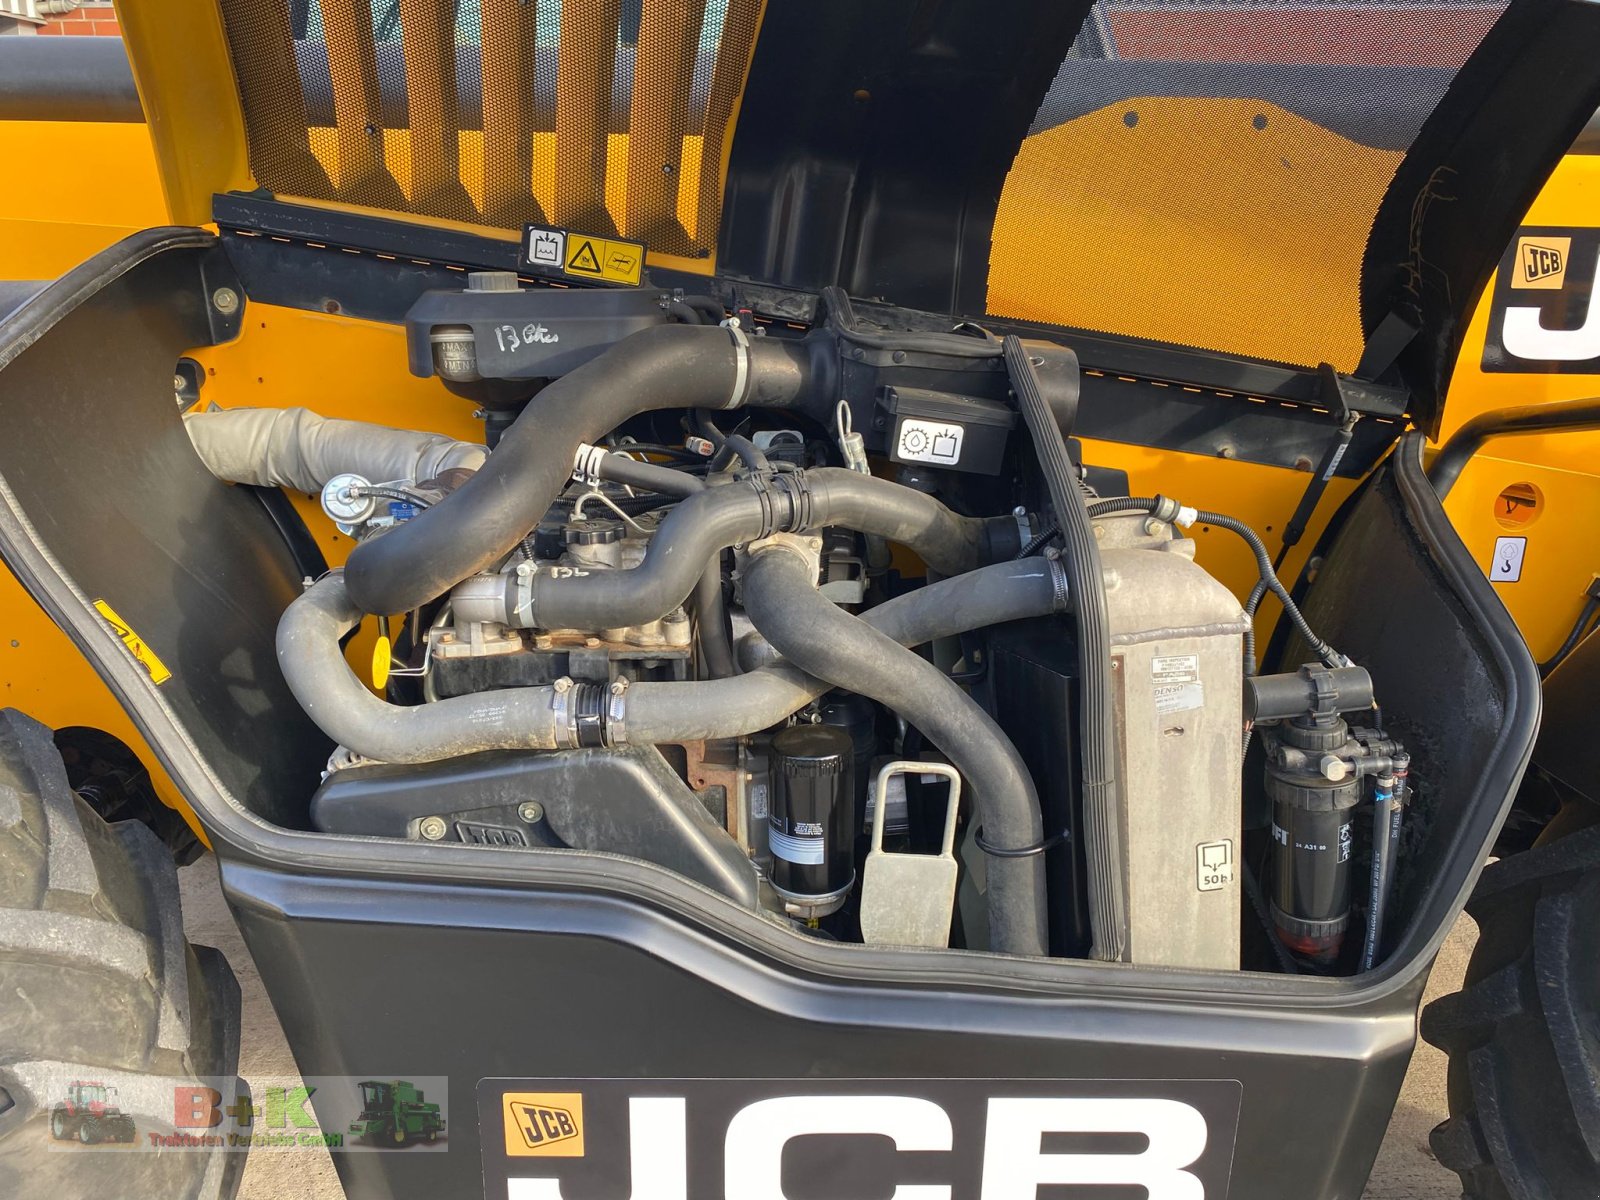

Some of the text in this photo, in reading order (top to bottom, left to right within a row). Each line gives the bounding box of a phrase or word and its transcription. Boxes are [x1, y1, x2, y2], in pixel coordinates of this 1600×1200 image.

[1527, 248, 1560, 278] JCB
[446, 342, 468, 352] MAX
[494, 325, 520, 353] 13
[448, 360, 471, 371] MIN
[1393, 813, 1401, 829] FUEL
[522, 1107, 574, 1143] JCB
[507, 1096, 1208, 1200] JCB
